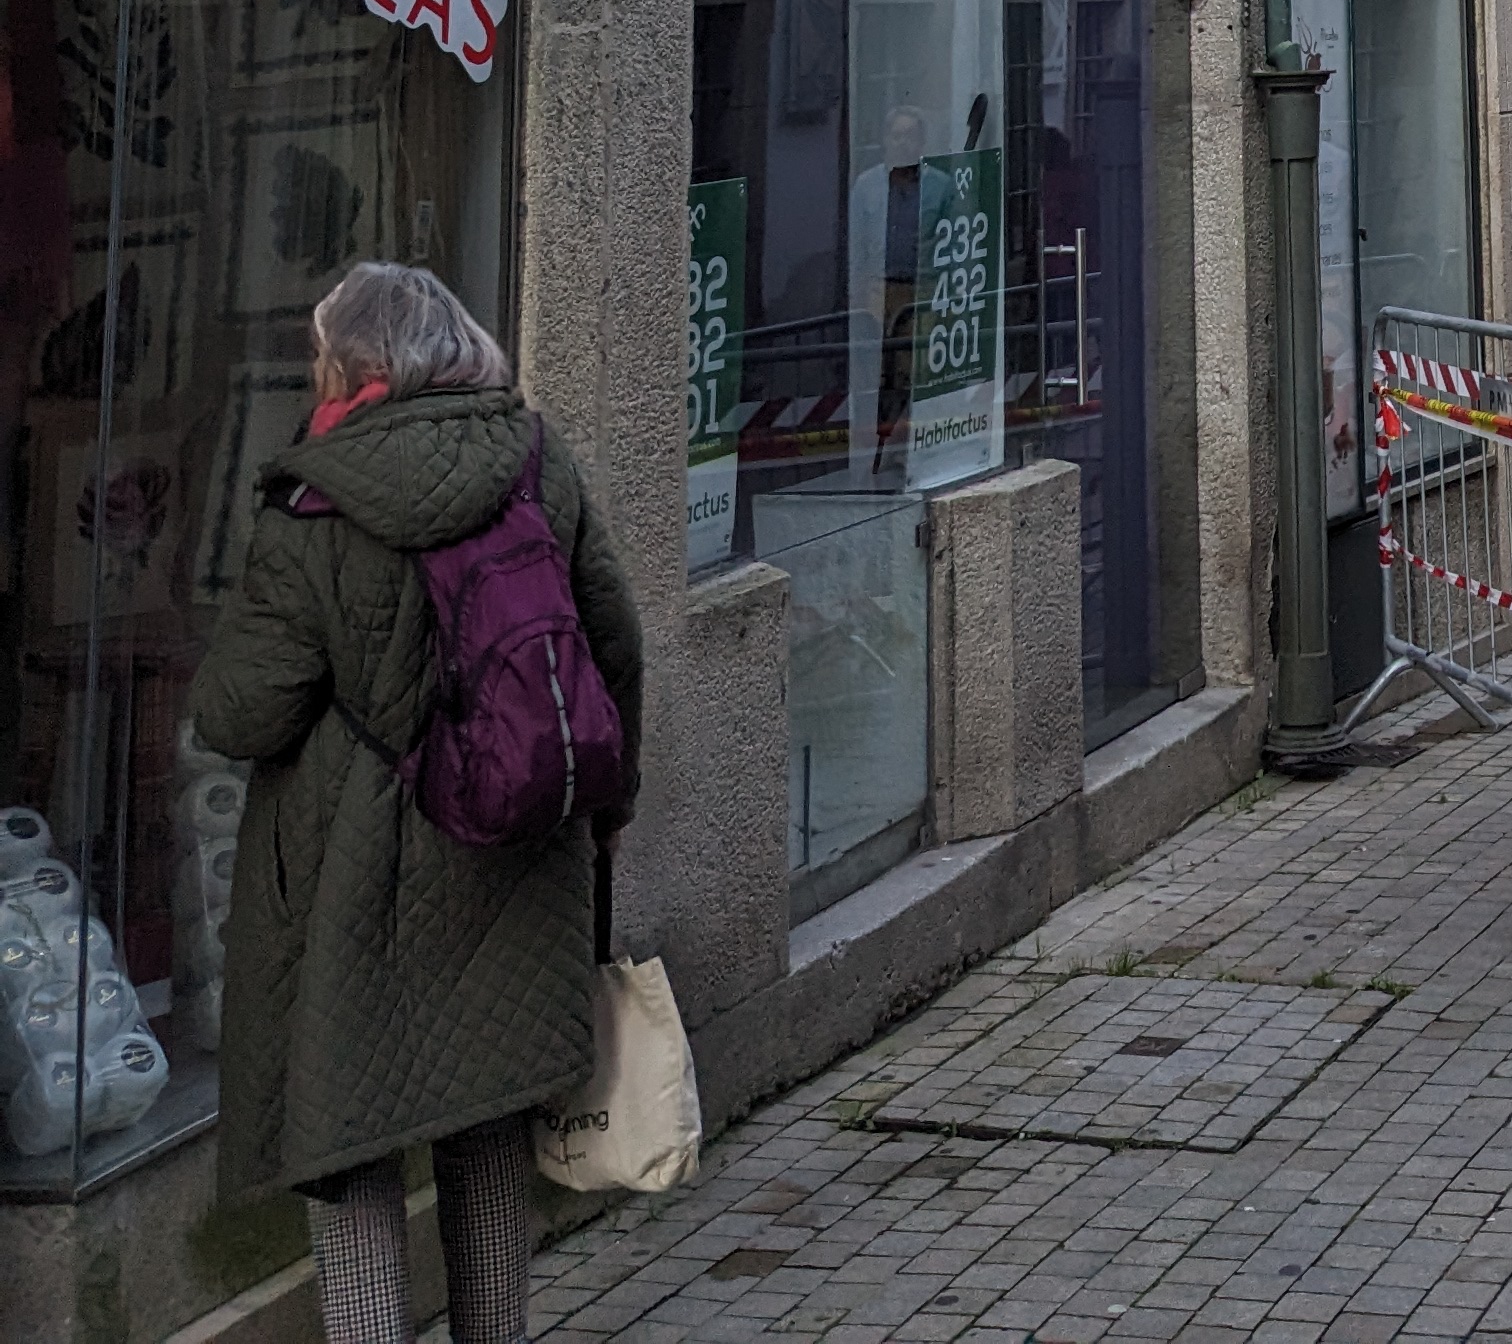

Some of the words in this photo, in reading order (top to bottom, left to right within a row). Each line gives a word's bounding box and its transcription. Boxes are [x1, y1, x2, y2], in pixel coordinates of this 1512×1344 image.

[933, 211, 988, 268] 232
[688, 255, 728, 312] 32
[931, 263, 987, 318] 432
[687, 316, 727, 379] 32
[928, 315, 980, 374] 601
[913, 412, 988, 452] Habifactus
